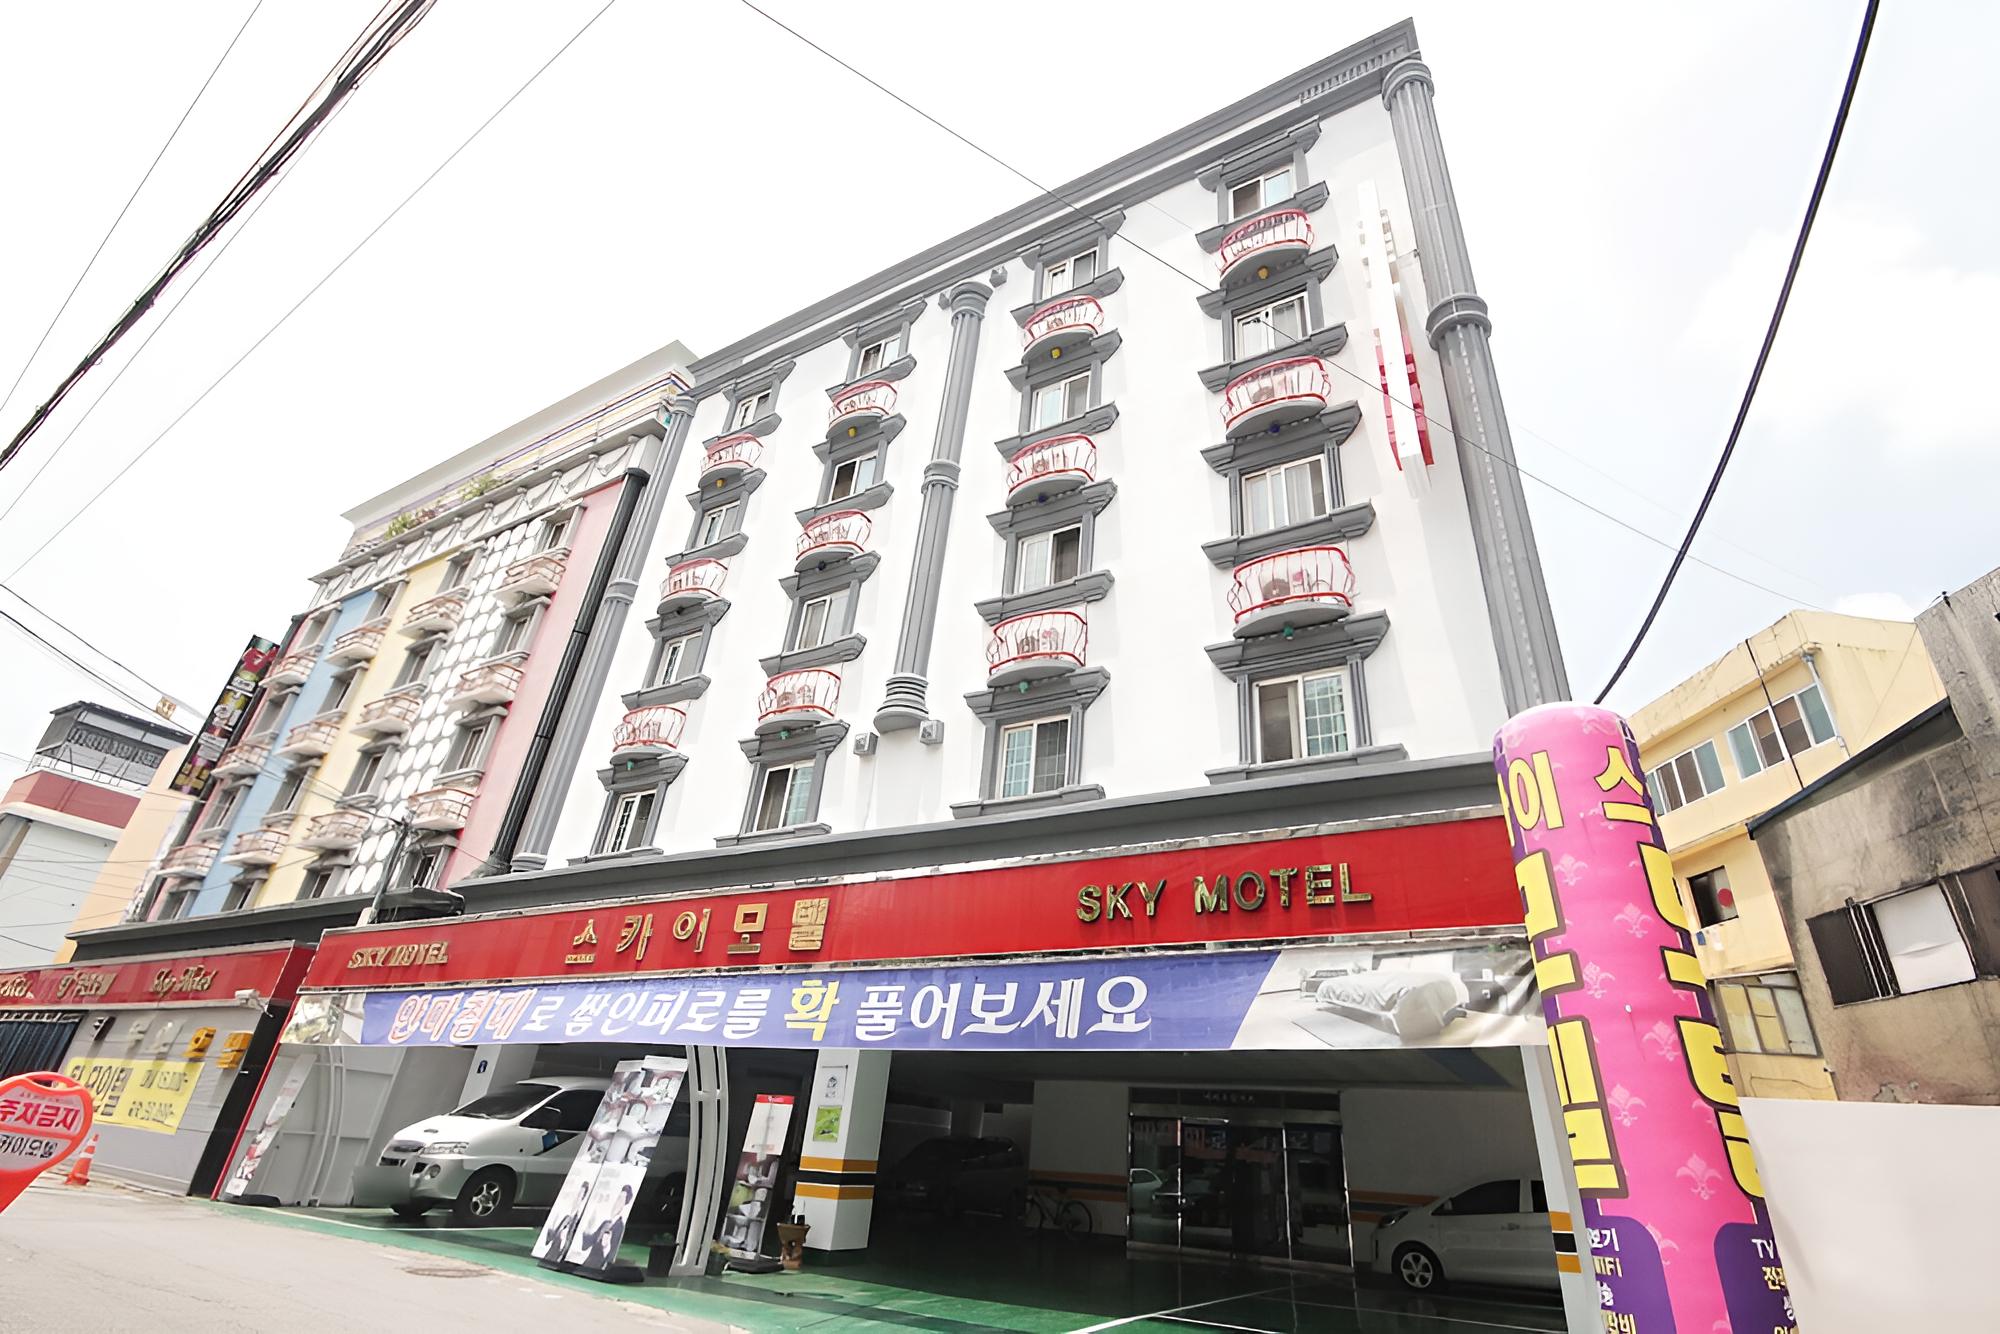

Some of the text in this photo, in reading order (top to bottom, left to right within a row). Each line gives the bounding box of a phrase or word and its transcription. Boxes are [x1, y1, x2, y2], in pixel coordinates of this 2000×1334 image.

[1077, 862, 1372, 923] SKY MOTEL
[347, 946, 392, 969] SKY
[565, 898, 829, 964] 스카이모텔
[784, 979, 840, 1041] 확
[855, 975, 1151, 1041] 풀어보세요
[0, 1099, 80, 1131] 주차금지
